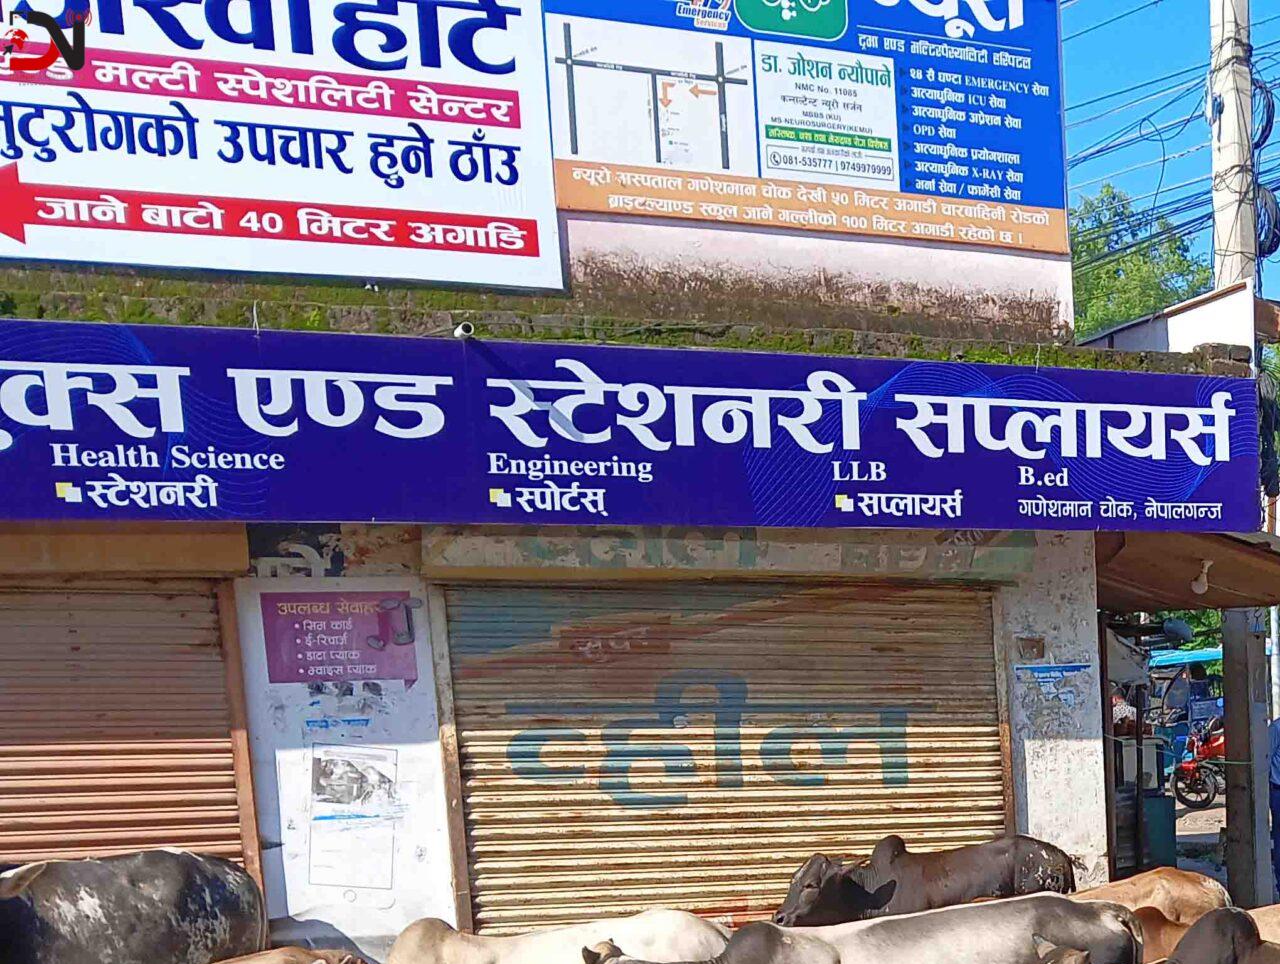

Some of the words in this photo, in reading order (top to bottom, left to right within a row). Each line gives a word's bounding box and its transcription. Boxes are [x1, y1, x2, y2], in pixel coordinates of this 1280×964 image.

[678, 4, 730, 21] Emergency
[695, 18, 726, 28] Services
[761, 54, 782, 73] डा.
[787, 51, 833, 80] जोशन
[837, 59, 892, 88] न्यौपाने
[91, 60, 200, 93] मल्टी
[214, 69, 395, 110] स्पेशलिटी
[407, 85, 513, 122] सेन्टर
[795, 82, 815, 92] NMC
[964, 75, 1029, 94] EMERGENCY
[1032, 82, 1049, 97] सेवा
[968, 94, 986, 106] ICU
[988, 94, 1006, 109] सेवा
[913, 124, 935, 136] OPD
[938, 124, 956, 139] सेवा
[1004, 114, 1022, 129] सेवा
[214, 119, 354, 174] उपचार
[368, 122, 434, 187] हुने
[447, 128, 520, 187] ठाँउ
[972, 167, 1004, 180] X-RAY
[1006, 168, 1024, 183] सेवा
[572, 166, 611, 186] न्यूरो
[687, 175, 756, 197] गणेशमान
[761, 182, 792, 199] चोक
[797, 185, 827, 203] देखी
[854, 190, 890, 210] मिटर
[894, 198, 936, 214] अगाडी
[1010, 208, 1049, 226] रोडको
[939, 179, 956, 195] सेवा
[1004, 186, 1021, 201] सेवा
[35, 195, 126, 224] जाने
[141, 200, 224, 231] बाटो
[239, 211, 283, 235] 40
[297, 210, 396, 242] मिटर
[408, 219, 527, 251] अगाडि
[743, 203, 773, 220] जाने
[872, 214, 906, 234] मिटर
[912, 222, 954, 238] अगाडी
[958, 224, 995, 242] रहेको
[1000, 231, 1013, 243] छ
[227, 367, 454, 440] एण्ड
[487, 358, 868, 454] स्टेशनरी
[895, 391, 1237, 466] सप्लायर्स
[50, 443, 160, 468] Health
[171, 445, 285, 470] Science
[487, 453, 653, 483] Engineering
[831, 460, 887, 482] LLB
[1018, 465, 1069, 488] B.ed
[86, 473, 218, 508] स्टेशनरी
[857, 489, 963, 518] सप्लायर्स
[1018, 498, 1093, 519] गणेशमान
[1099, 496, 1137, 521] चोक,
[1144, 497, 1222, 520] नेपालगन्ज
[277, 602, 331, 616] उपलब्ध
[330, 617, 353, 631] कार्ड
[306, 651, 326, 661] डाटा
